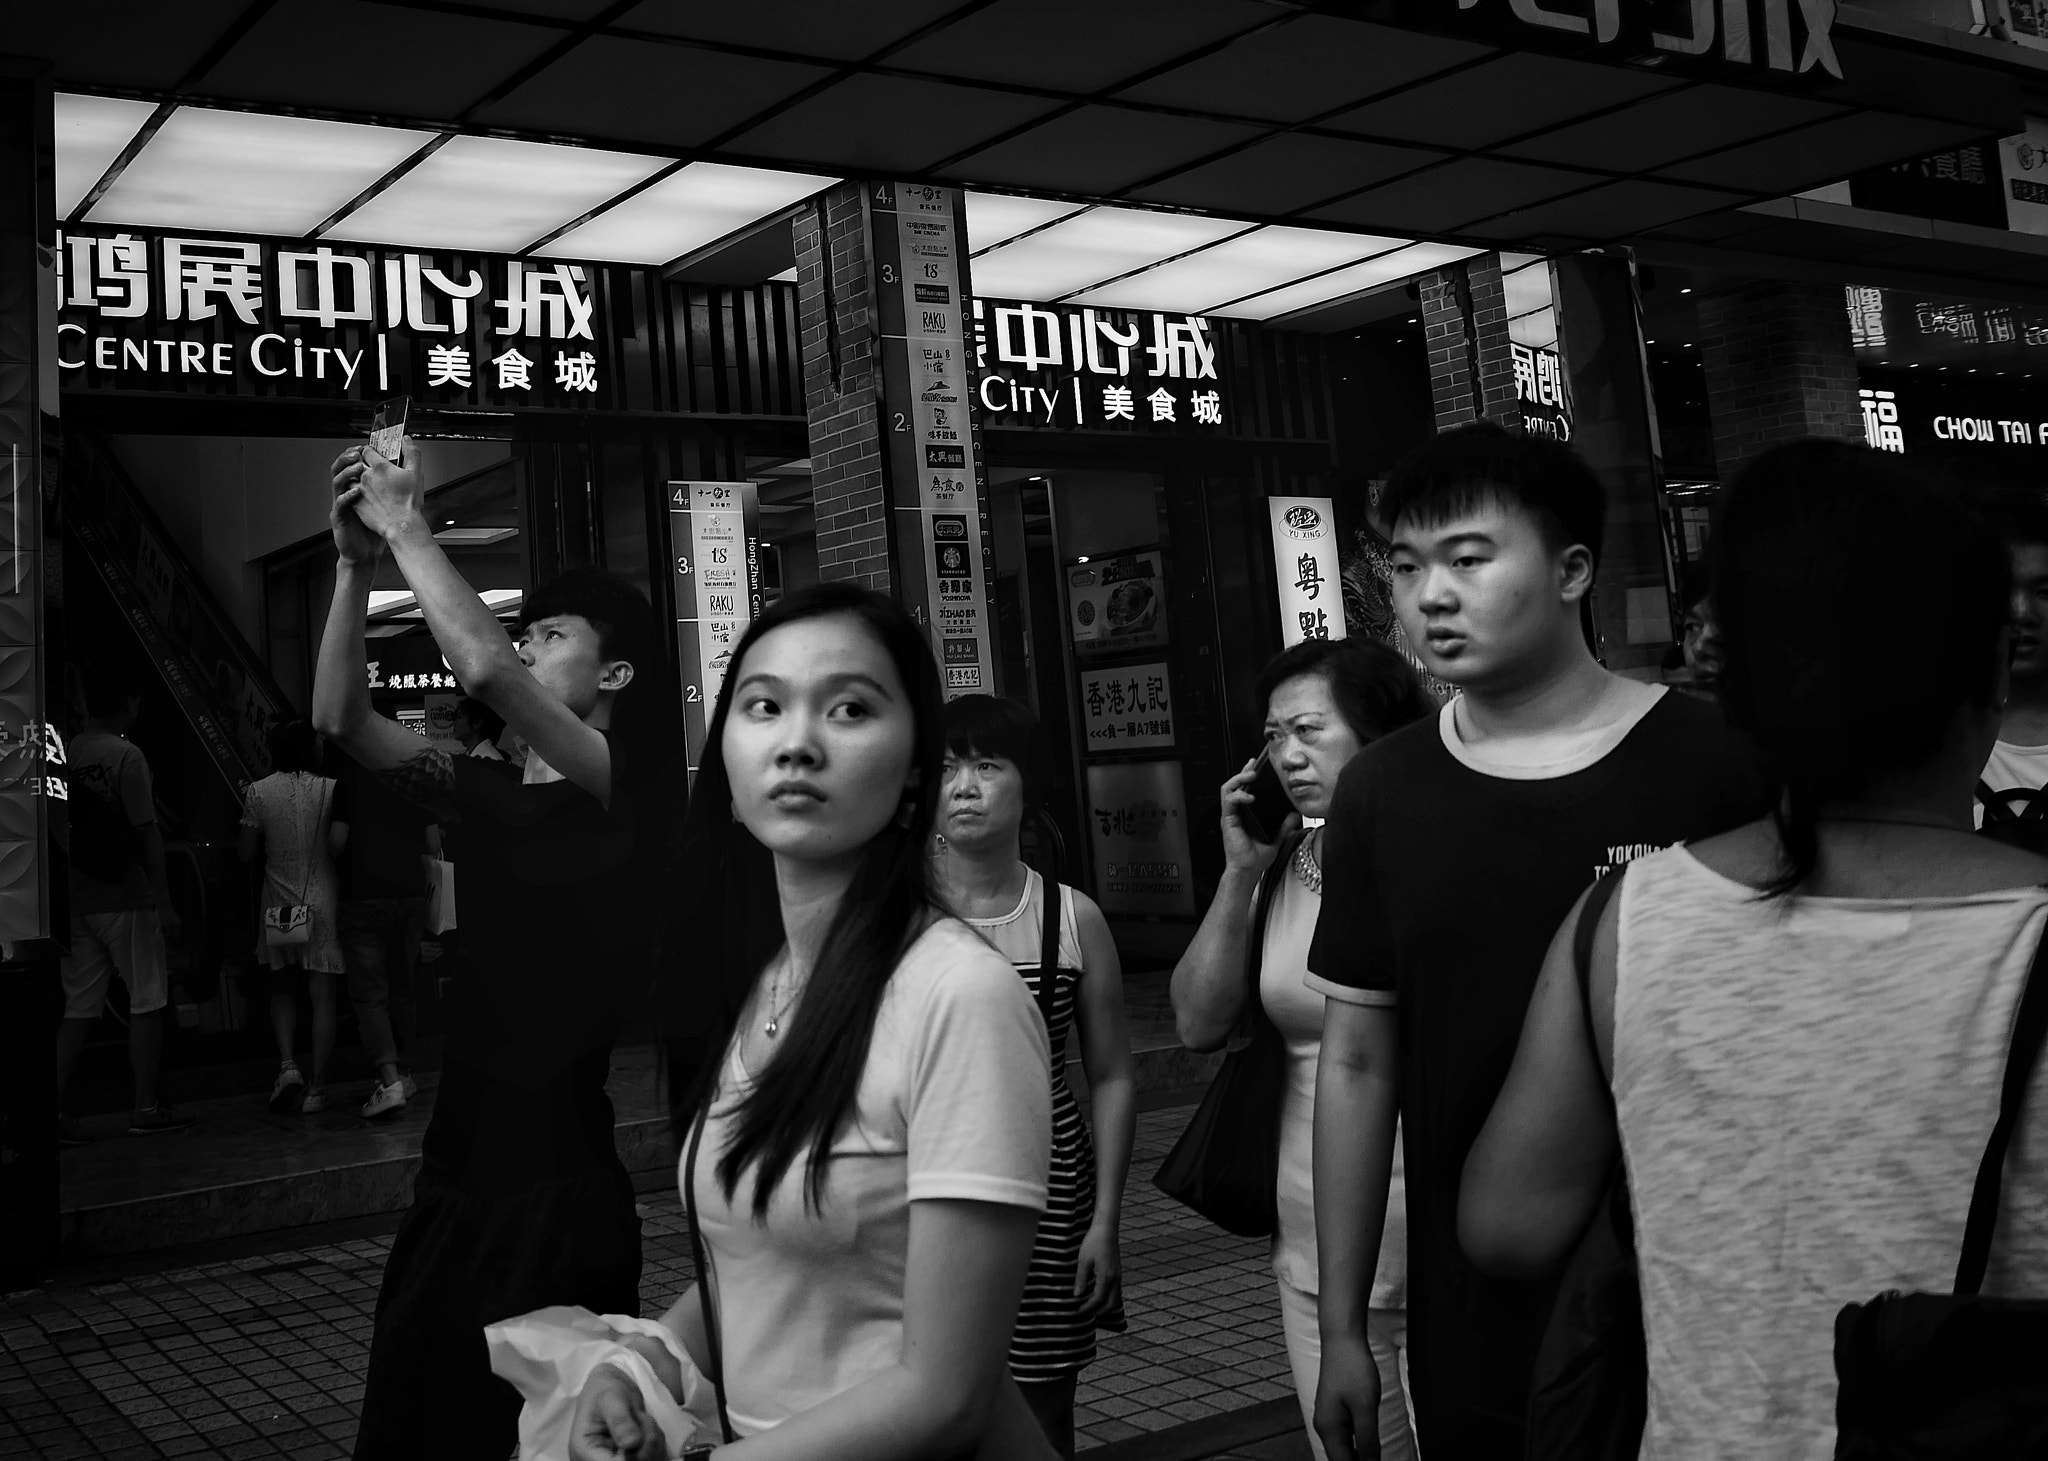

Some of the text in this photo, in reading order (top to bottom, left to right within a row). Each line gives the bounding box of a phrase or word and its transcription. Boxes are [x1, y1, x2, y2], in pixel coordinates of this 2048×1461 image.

[922, 311, 947, 330] RAKU
[427, 343, 598, 393] 美食城
[1102, 383, 1223, 425] 美食城
[1933, 415, 1995, 442] CHOW
[1997, 420, 2033, 445] TAI
[747, 536, 761, 621] HongZhan Cent
[710, 595, 734, 612] RAKU
[1086, 675, 1169, 718] 香港九記
